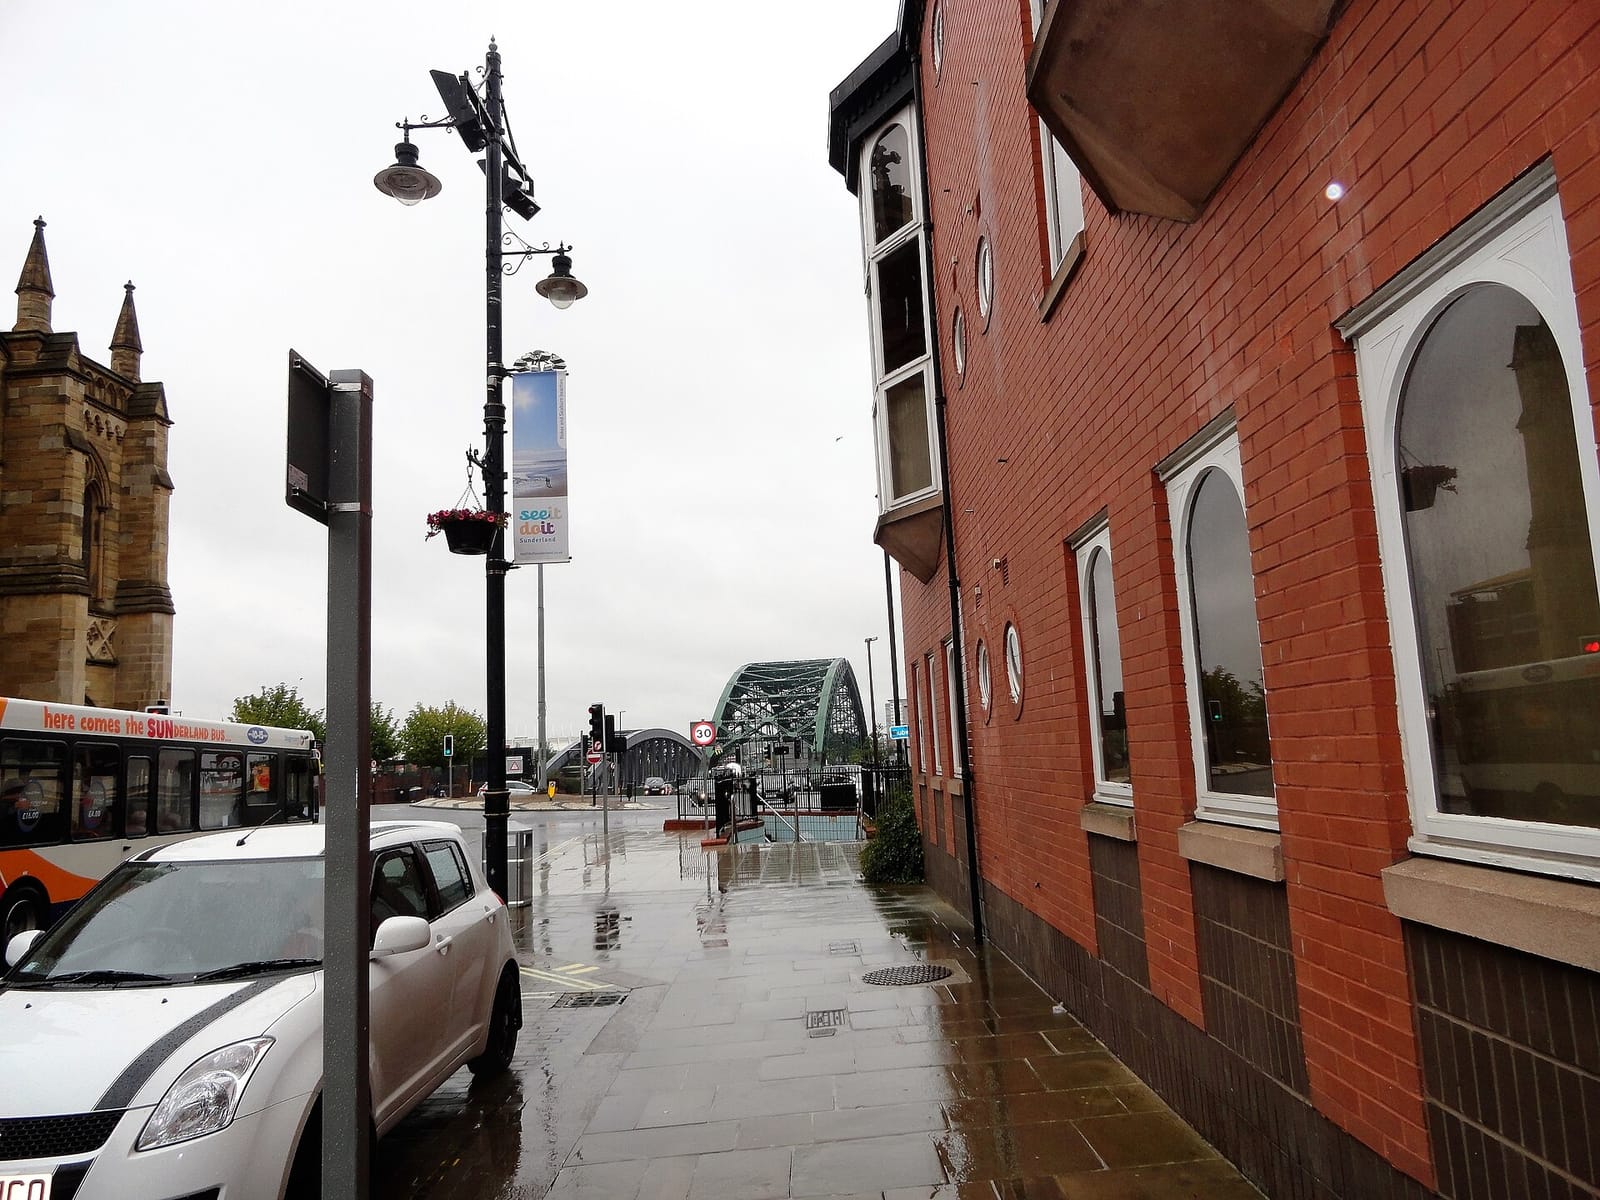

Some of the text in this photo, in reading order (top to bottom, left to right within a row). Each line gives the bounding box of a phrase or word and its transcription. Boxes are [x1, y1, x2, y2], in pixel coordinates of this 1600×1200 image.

[519, 536, 556, 544] Sunderland
[43, 705, 75, 730] here
[80, 715, 121, 734] comes
[125, 714, 144, 735] the
[696, 728, 712, 739] 30
